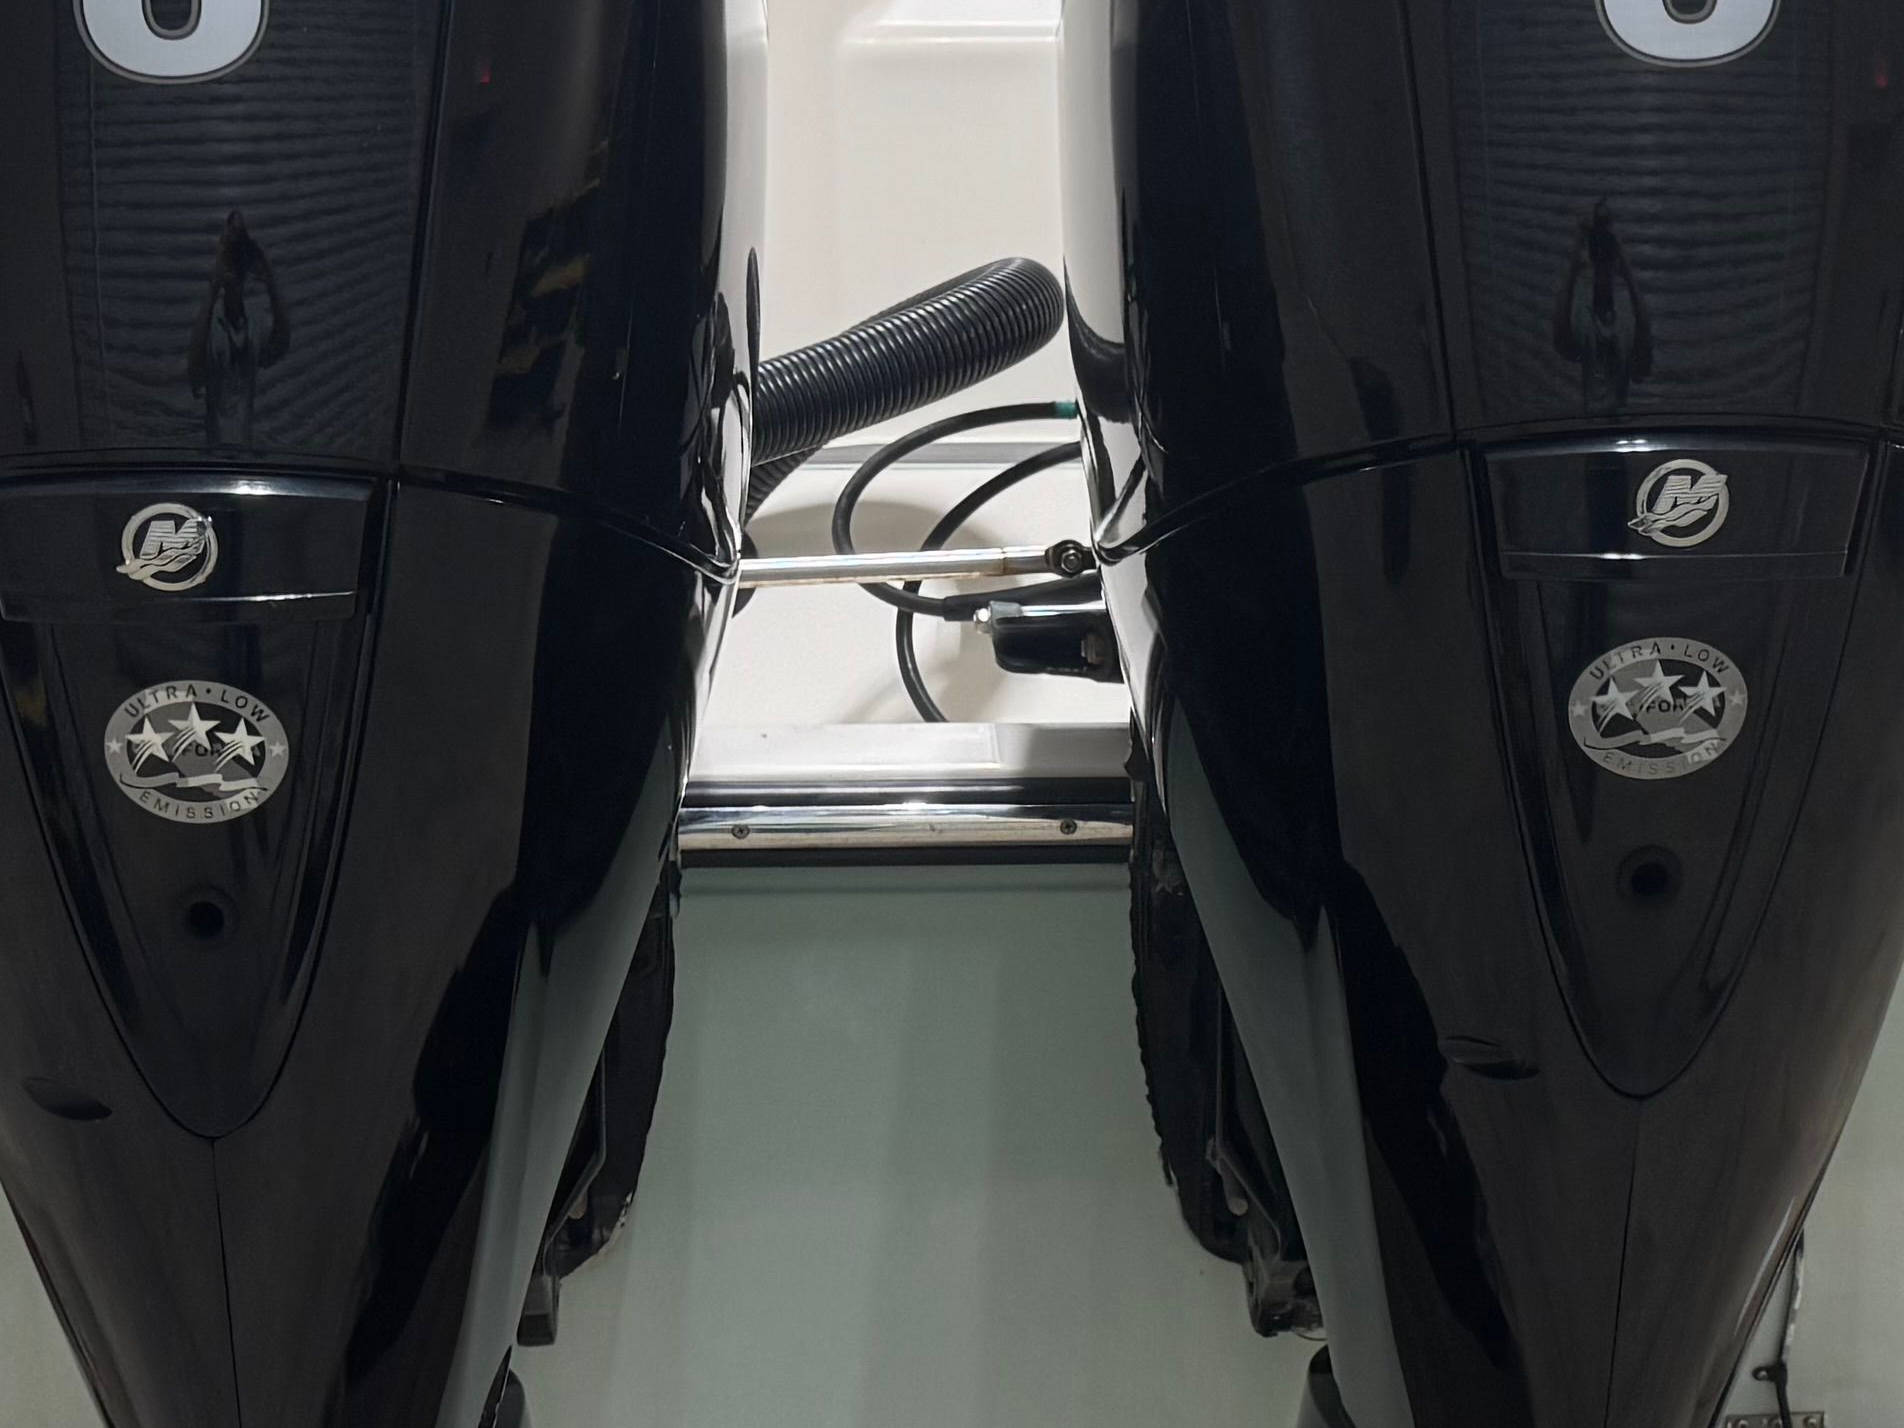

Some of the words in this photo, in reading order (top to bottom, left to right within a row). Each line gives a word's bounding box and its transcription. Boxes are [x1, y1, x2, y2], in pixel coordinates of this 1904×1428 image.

[1589, 641, 1661, 680] ULTRA
[1684, 644, 1730, 674] LOW
[124, 684, 198, 719] ULTRA
[220, 689, 270, 722] LOW
[1602, 743, 1720, 775] EMISSION
[139, 790, 259, 819] EMISSION
